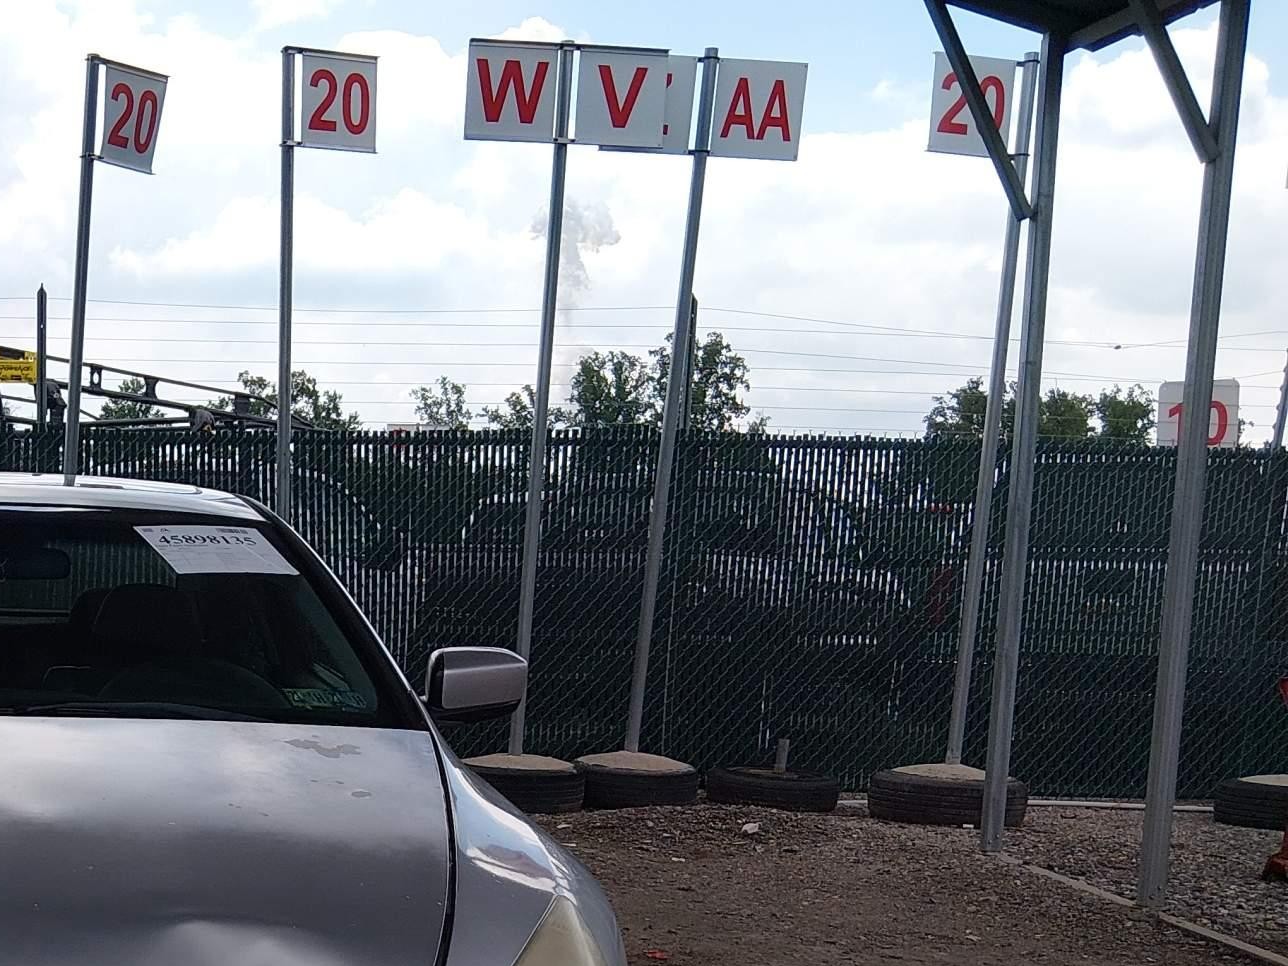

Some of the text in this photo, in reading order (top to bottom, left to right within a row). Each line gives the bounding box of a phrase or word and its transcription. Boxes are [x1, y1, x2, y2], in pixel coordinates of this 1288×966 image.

[107, 82, 159, 155] 20
[308, 68, 372, 136] 20
[475, 58, 550, 124] W
[598, 64, 649, 128] V
[719, 77, 791, 142] AA
[936, 70, 1006, 136] 20
[158, 534, 258, 546] 45898135
